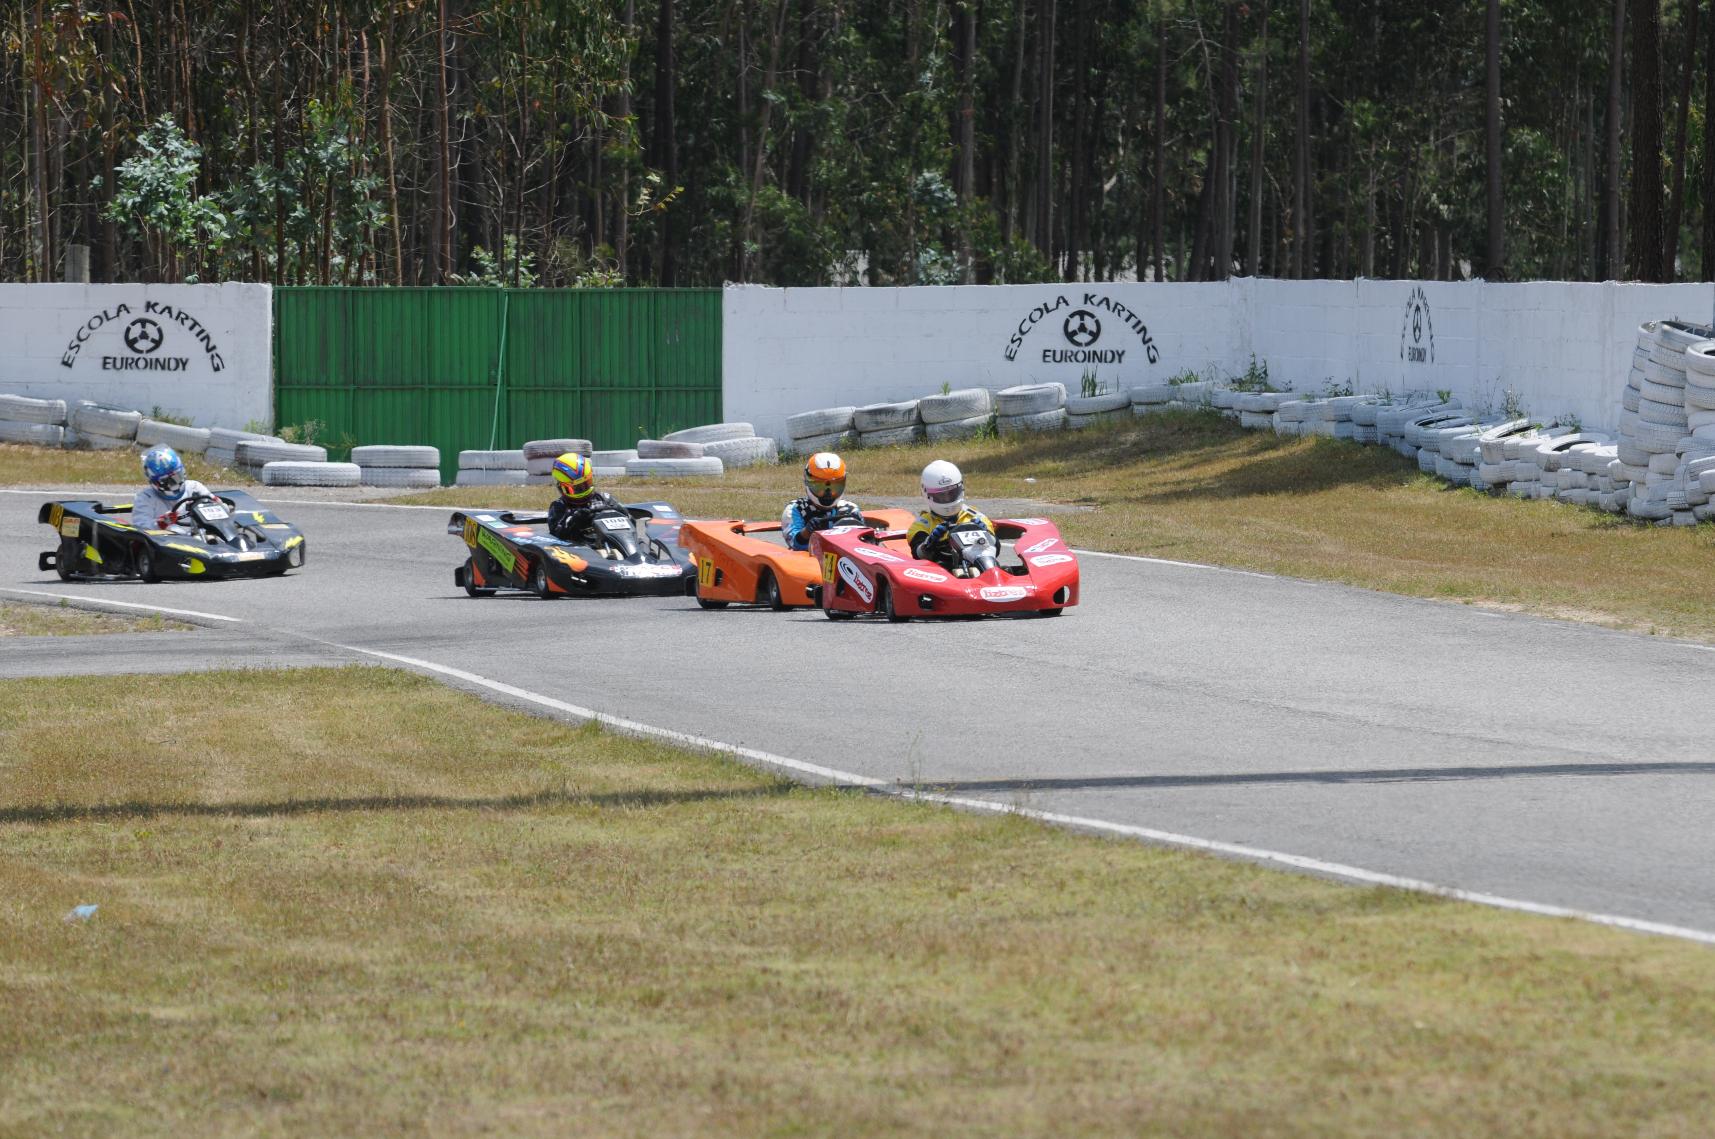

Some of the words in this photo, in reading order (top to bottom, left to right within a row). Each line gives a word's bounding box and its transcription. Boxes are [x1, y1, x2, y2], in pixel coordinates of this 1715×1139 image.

[61, 303, 131, 369] ESCOLA
[145, 300, 225, 372] KARTING
[1004, 295, 1069, 361] ESCOLA
[1084, 293, 1160, 364] KARTING
[102, 356, 189, 371] EUROINDY
[1042, 350, 1126, 363] EUROINDY
[700, 559, 712, 585] 17
